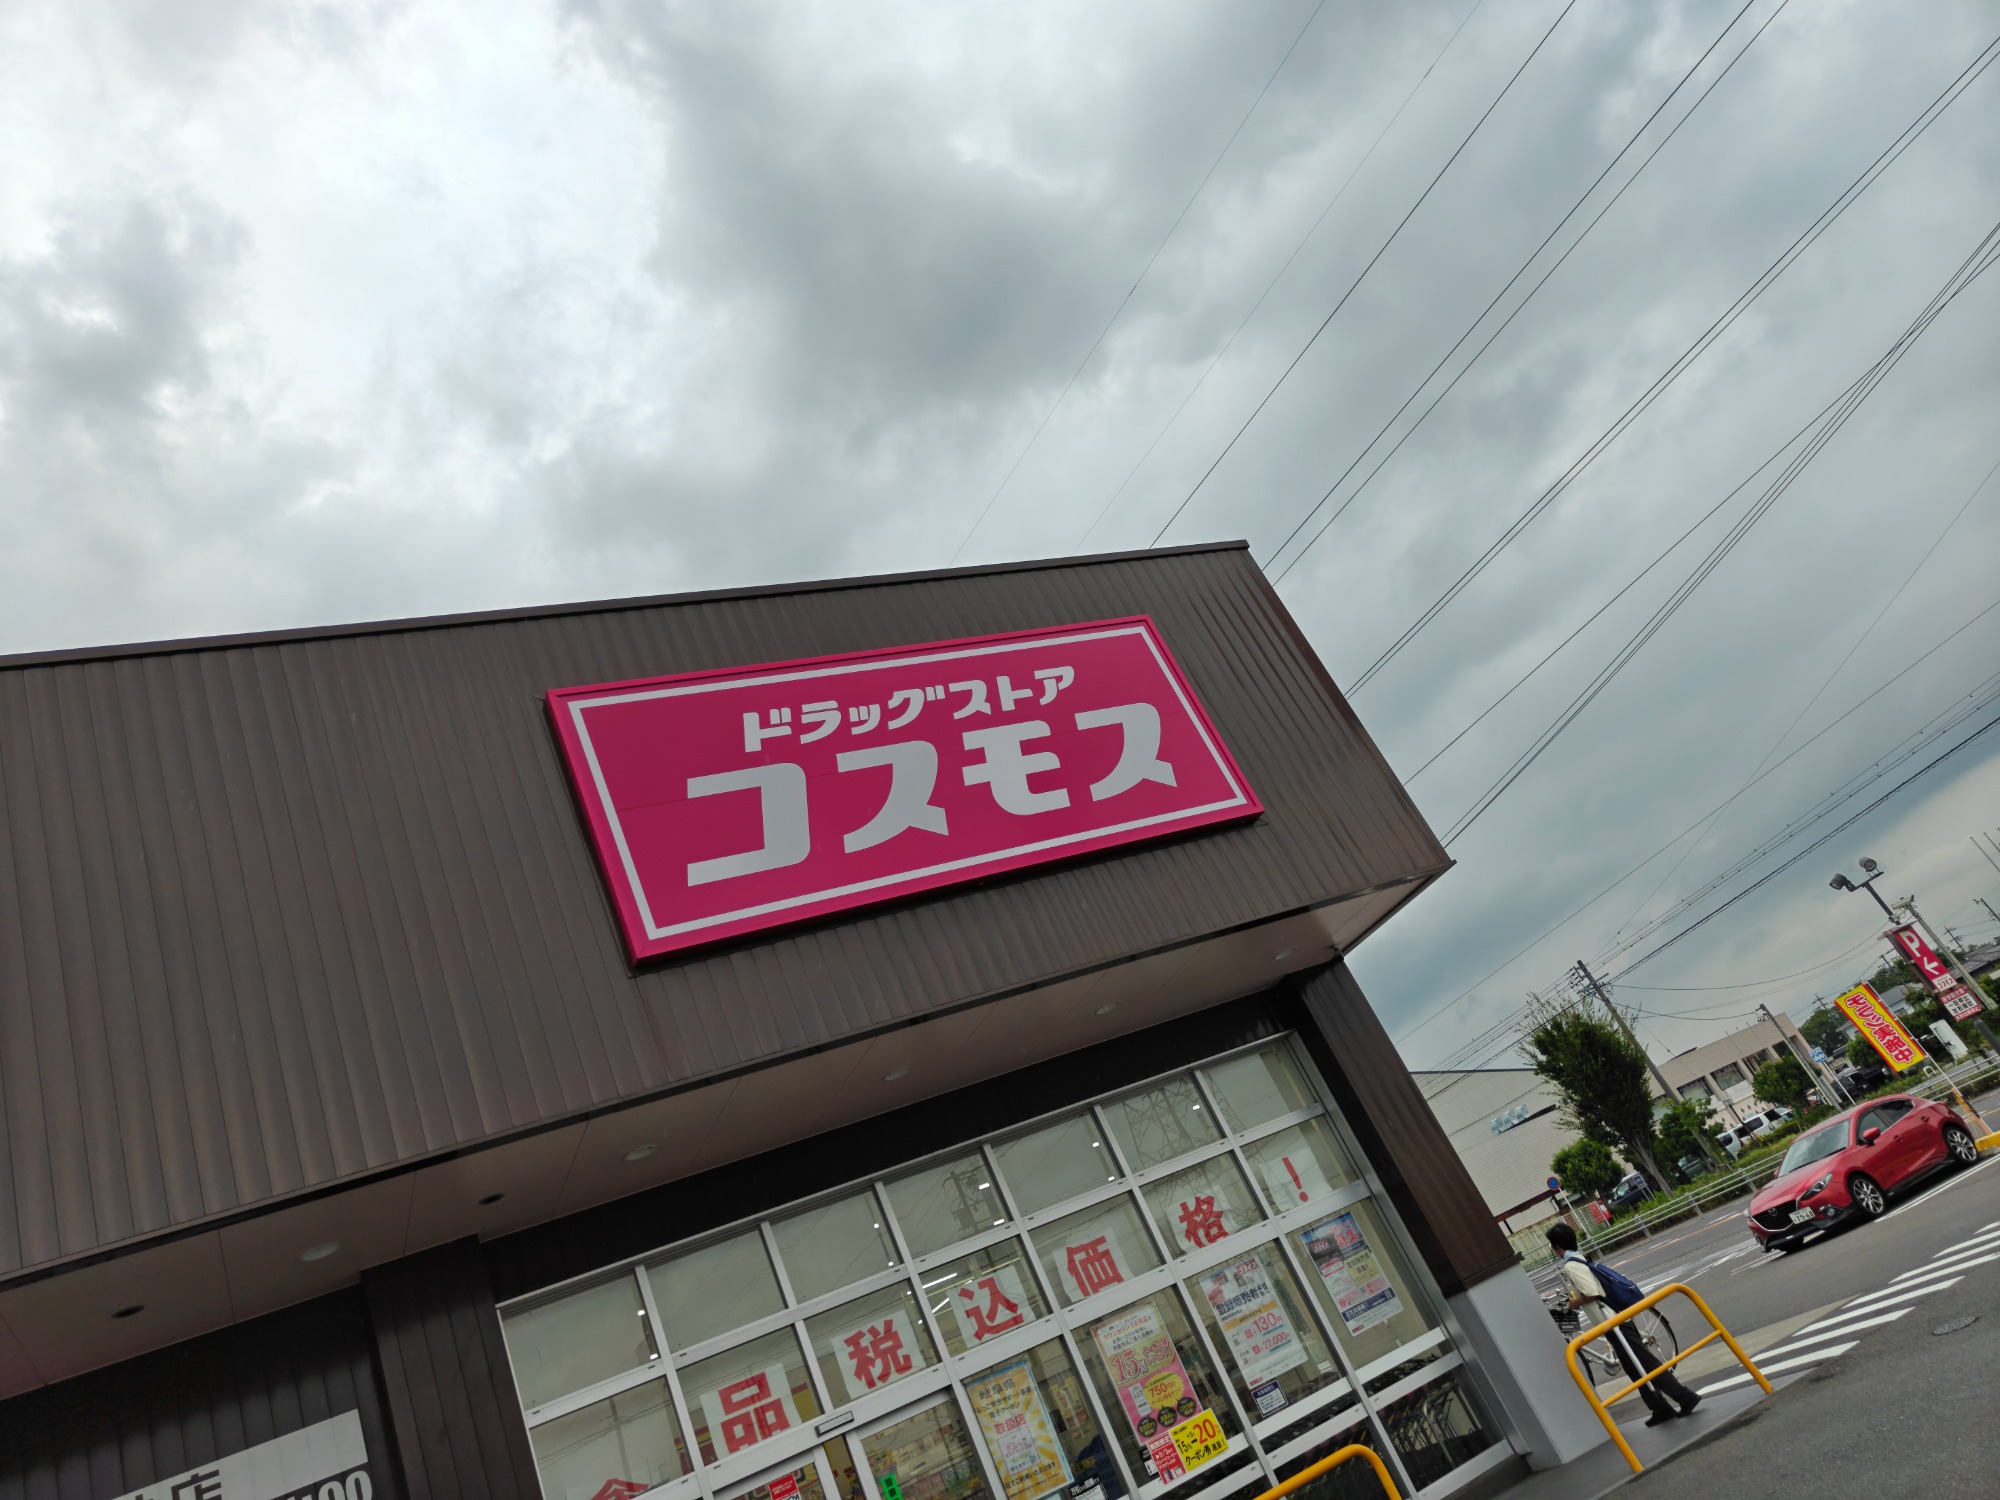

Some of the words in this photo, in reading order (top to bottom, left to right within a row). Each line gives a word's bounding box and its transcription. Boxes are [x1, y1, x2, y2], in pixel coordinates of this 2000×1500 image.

[743, 665, 1076, 753] ドラッグストア
[686, 702, 1179, 887] コスモス
[1900, 930, 1921, 957] P
[1334, 1228, 1360, 1248] 募集
[994, 1413, 1027, 1435] 取扱店
